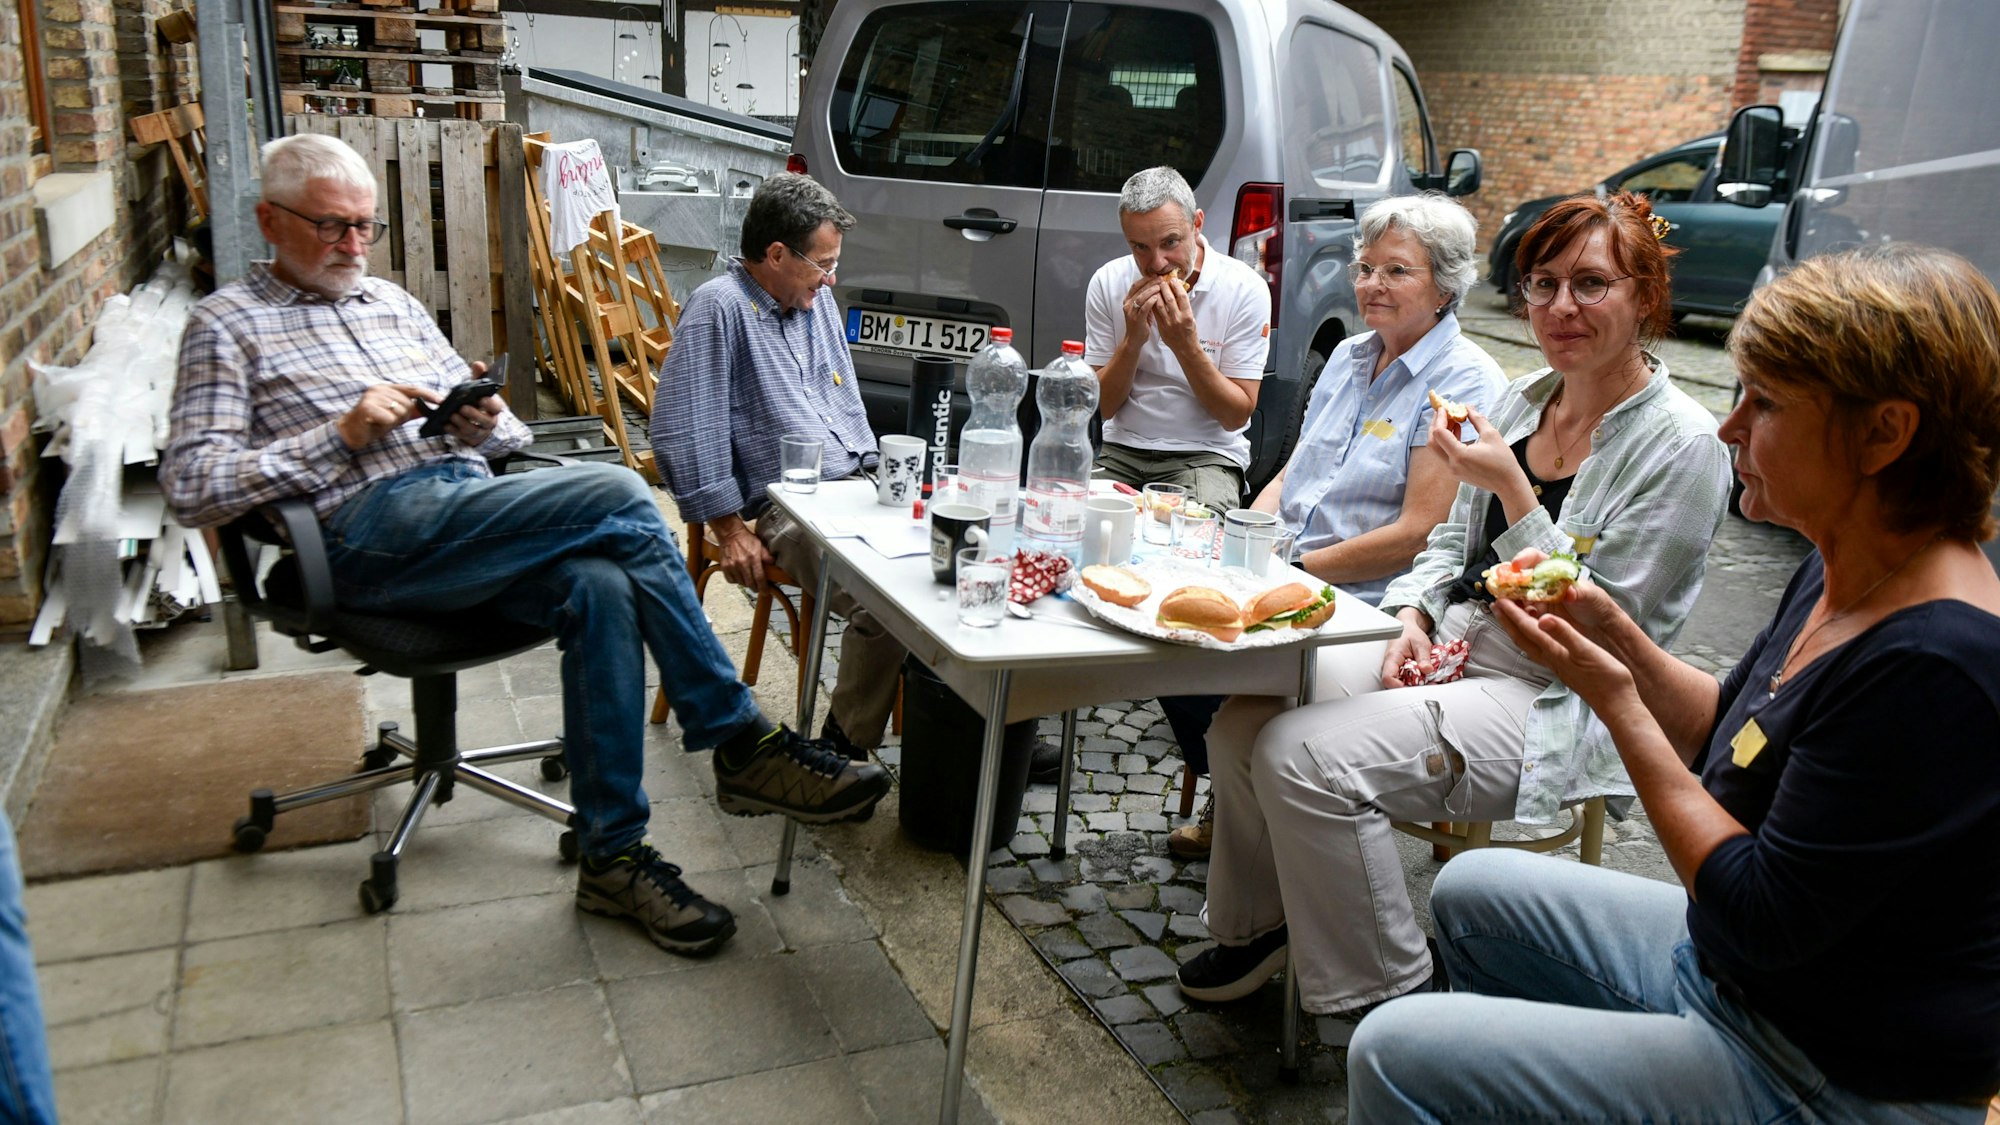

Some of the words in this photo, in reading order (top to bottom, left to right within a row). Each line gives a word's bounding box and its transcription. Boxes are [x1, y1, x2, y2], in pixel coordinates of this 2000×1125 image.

[859, 314, 890, 342] BM
[906, 320, 933, 348] TI
[940, 324, 985, 353] 512
